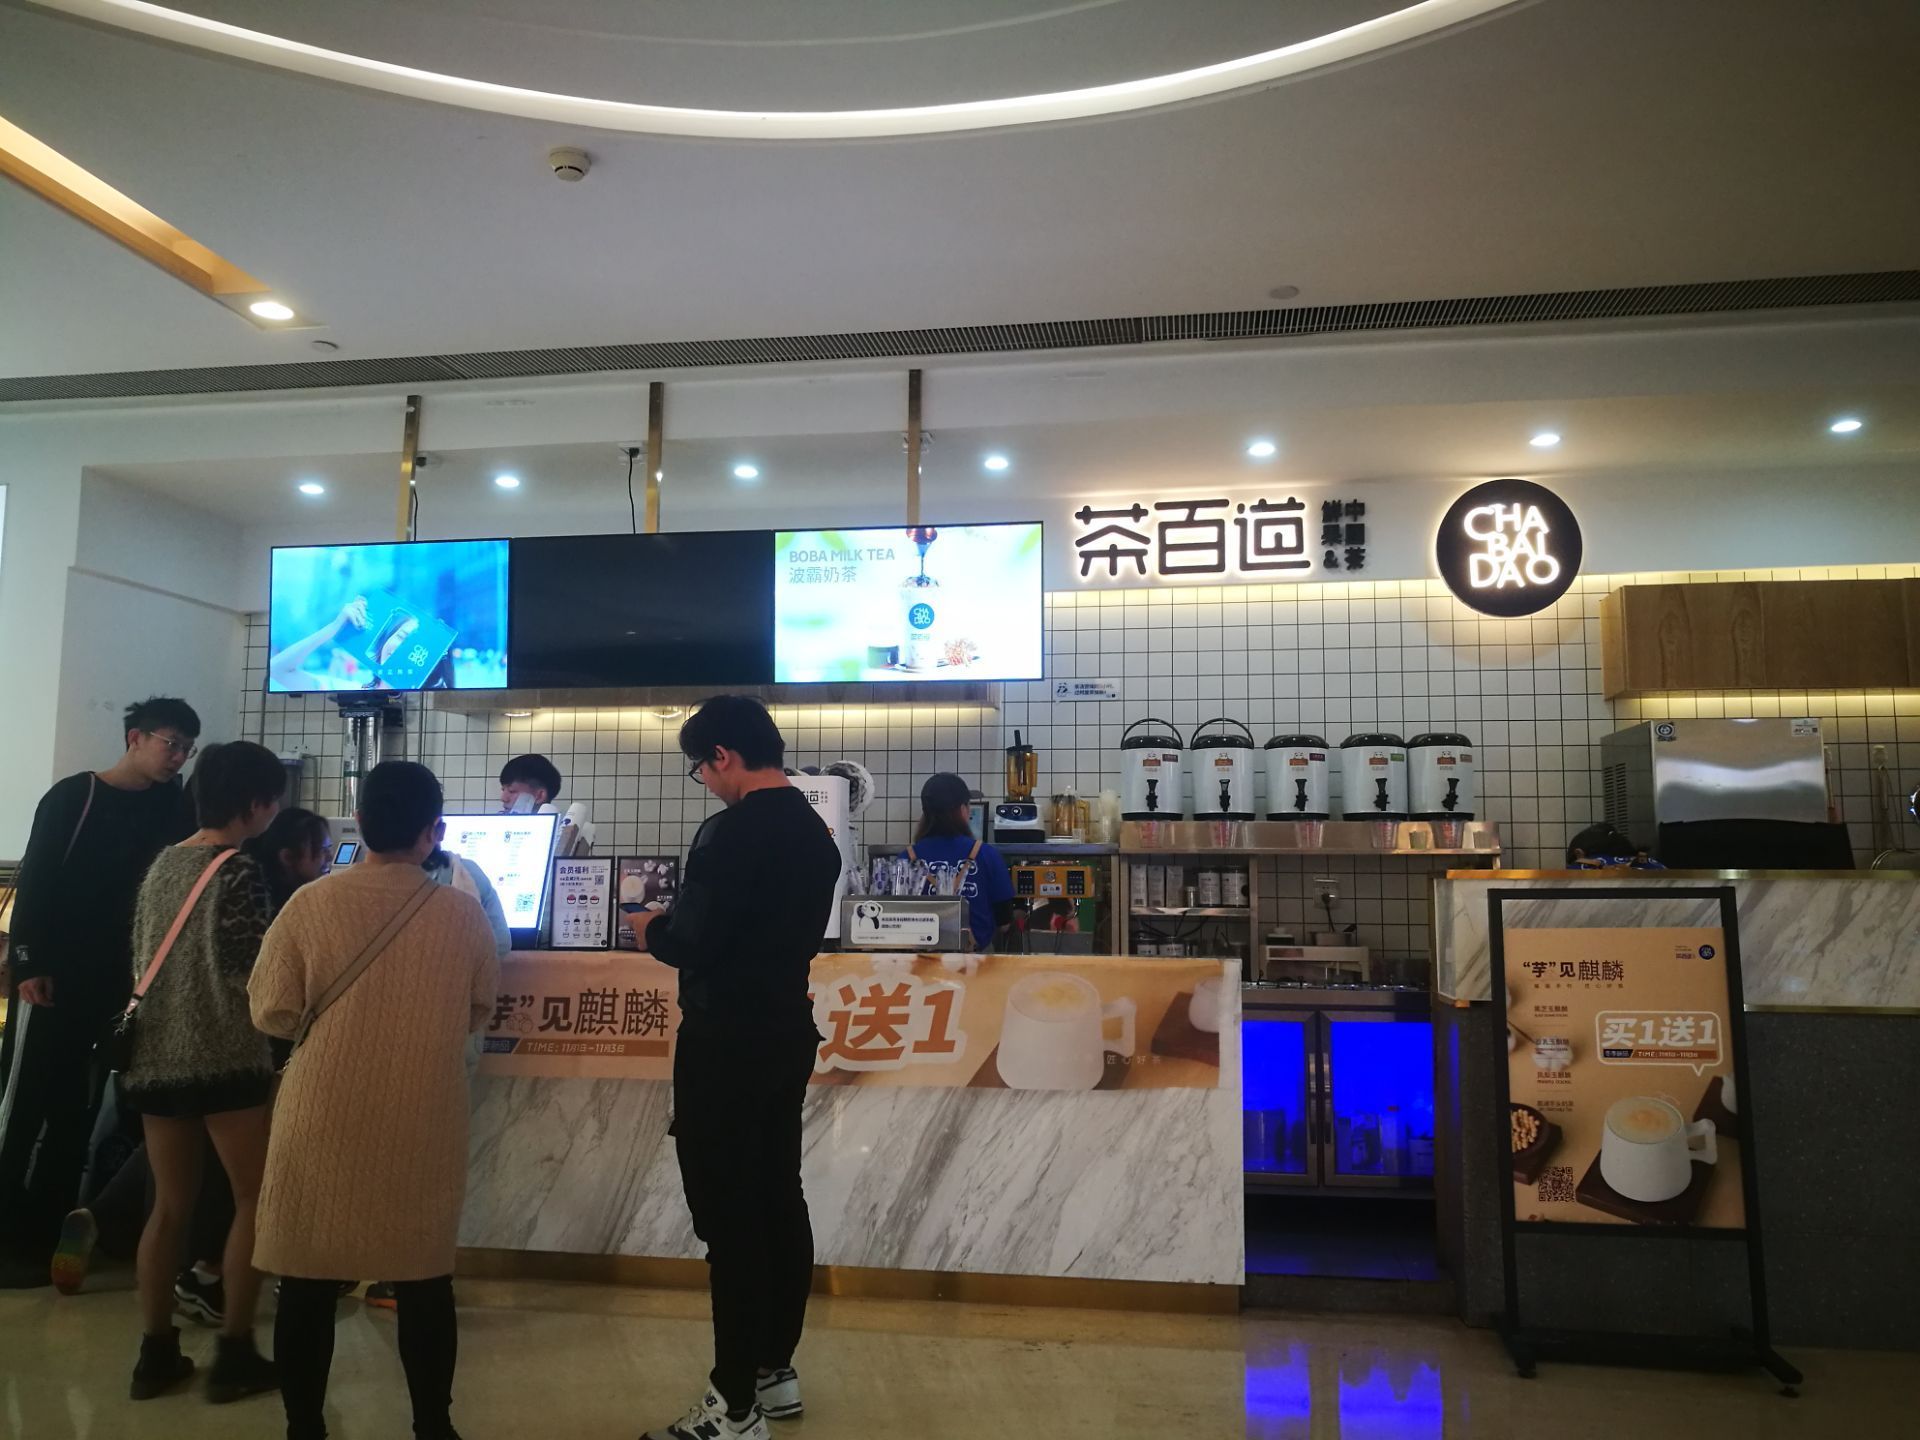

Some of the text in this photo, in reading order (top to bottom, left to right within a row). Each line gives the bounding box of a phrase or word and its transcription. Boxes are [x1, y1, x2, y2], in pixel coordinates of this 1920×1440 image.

[1074, 496, 1312, 576] 茶百道
[1464, 503, 1551, 541] CHA
[789, 548, 896, 563] BOBA MILK TEA
[1487, 531, 1545, 563] BAI
[789, 566, 857, 585] 波霸奶茶
[1469, 553, 1560, 588] DAO
[1601, 1015, 1716, 1047] 买1送1
